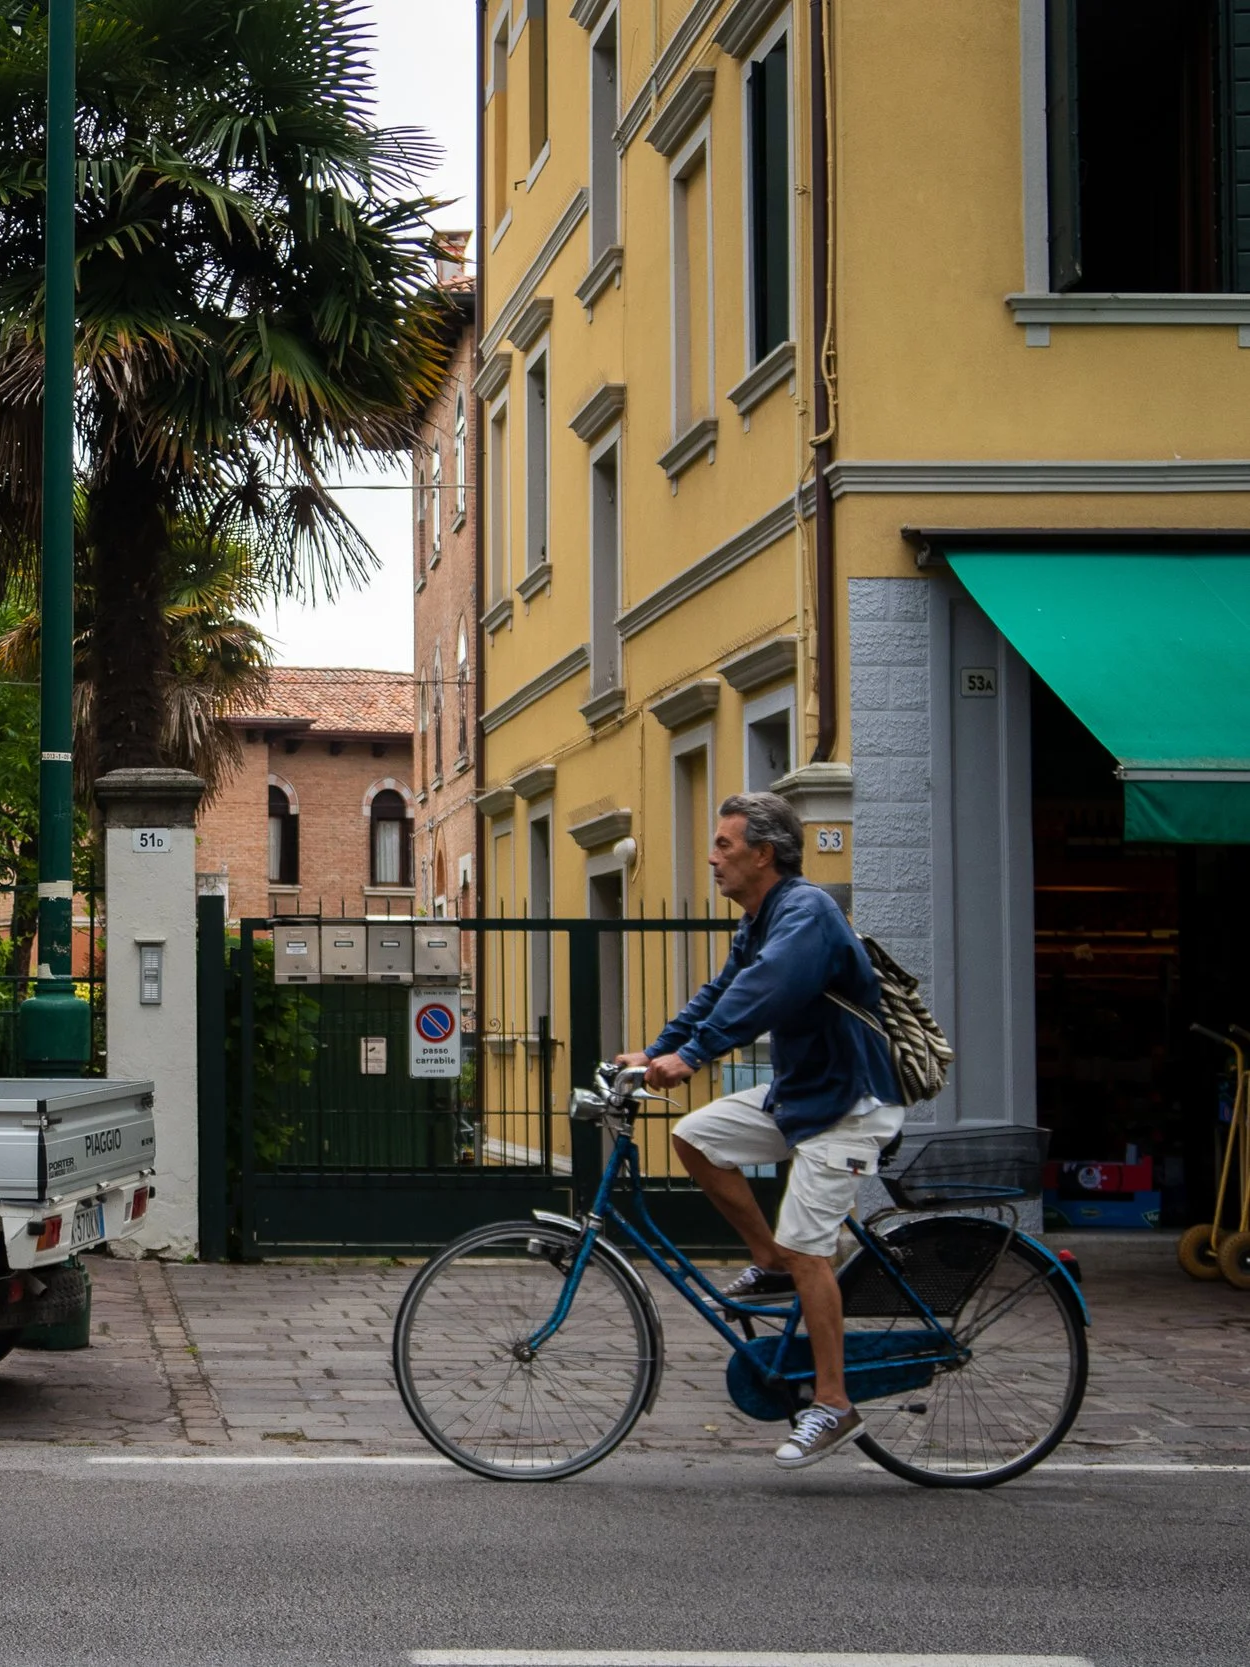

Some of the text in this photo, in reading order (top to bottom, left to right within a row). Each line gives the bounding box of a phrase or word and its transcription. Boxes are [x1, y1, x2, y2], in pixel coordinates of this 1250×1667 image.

[968, 675, 994, 691] 53A
[140, 832, 164, 848] 51D
[820, 831, 841, 848] 53
[415, 1057, 456, 1065] carrabile
[85, 1128, 122, 1158] PIAGGIO
[49, 1157, 75, 1171] PORTER
